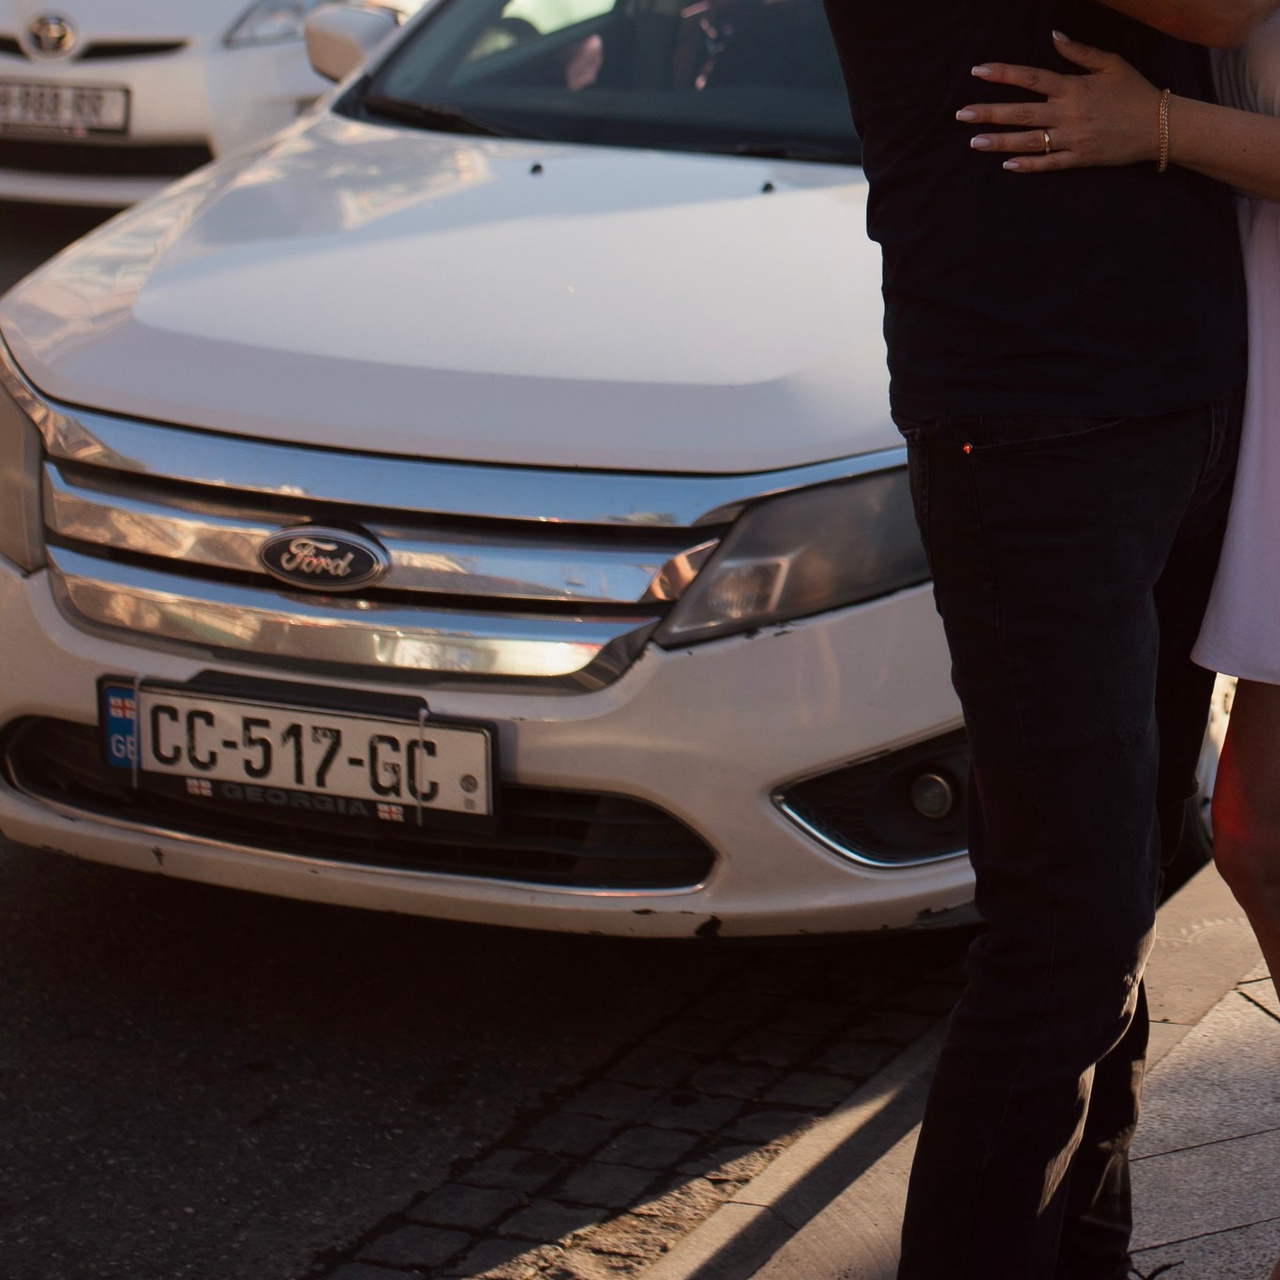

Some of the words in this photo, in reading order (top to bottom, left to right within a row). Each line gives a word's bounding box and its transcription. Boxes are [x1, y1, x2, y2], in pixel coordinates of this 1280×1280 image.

[280, 538, 355, 577] Ford
[150, 704, 439, 803] CC-517-GC
[220, 782, 370, 818] GEORGIA
